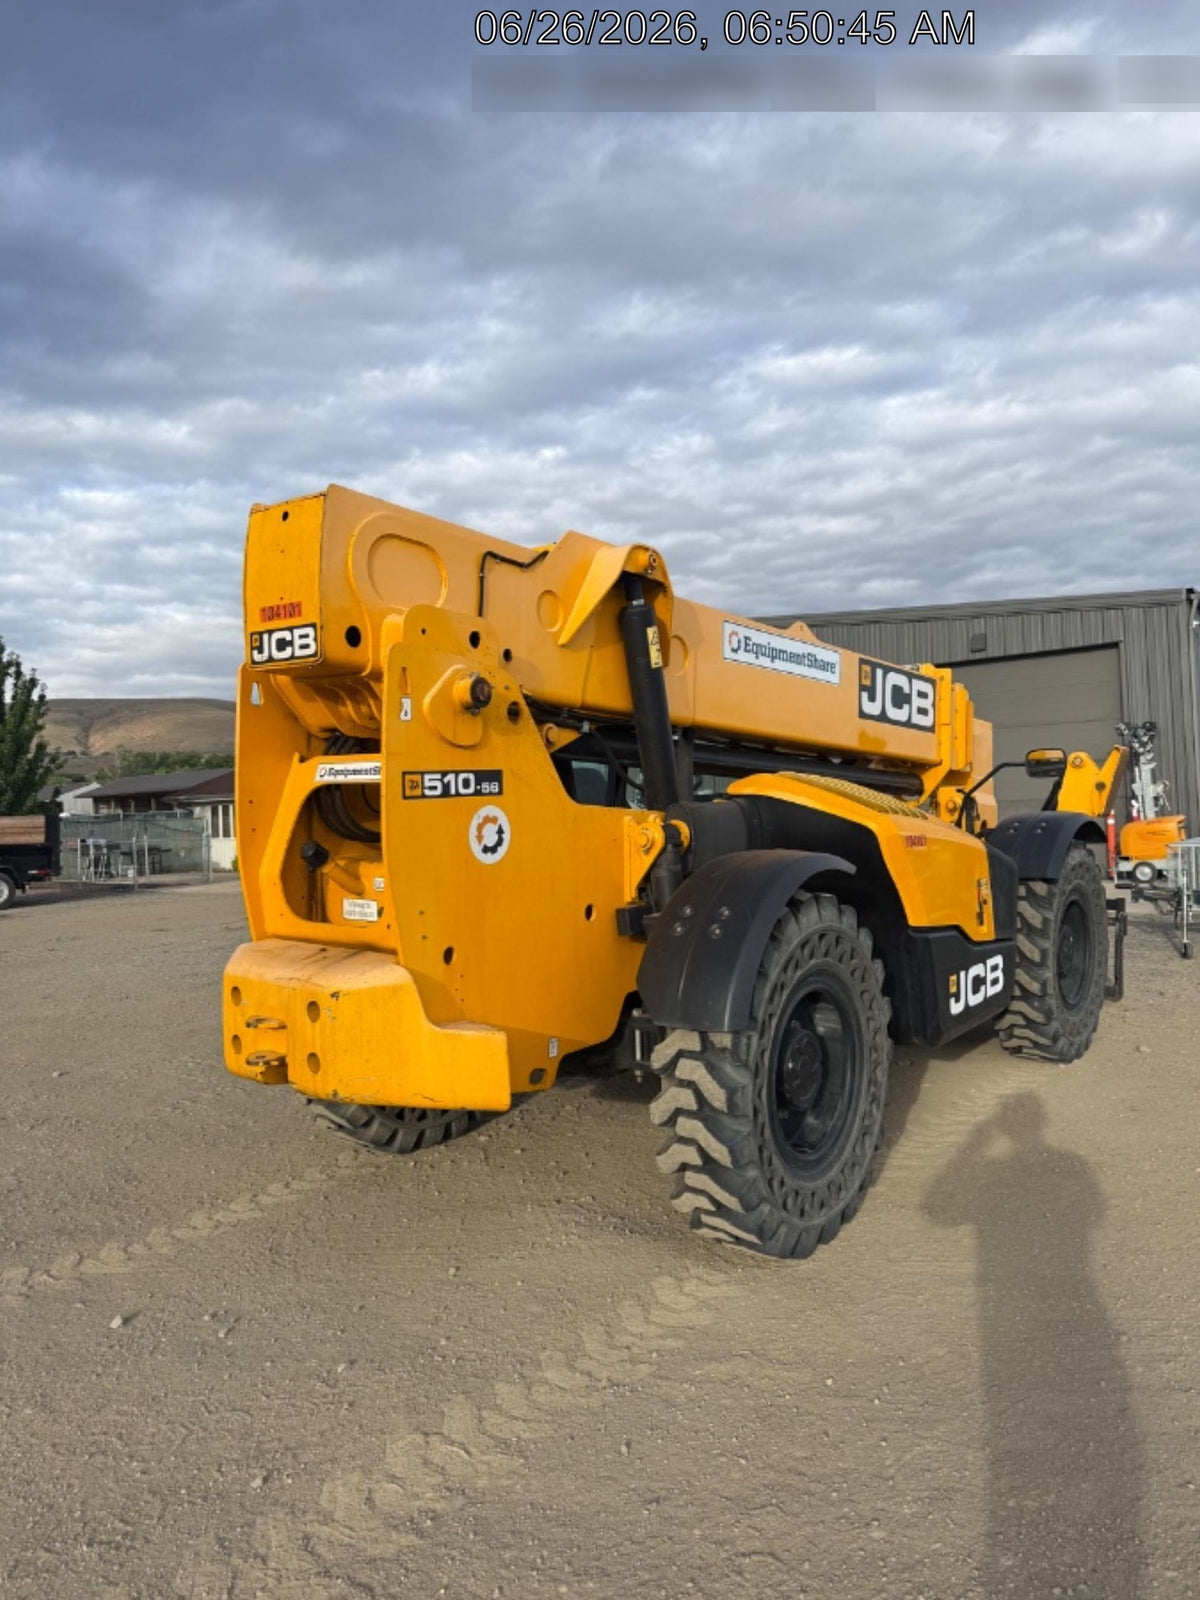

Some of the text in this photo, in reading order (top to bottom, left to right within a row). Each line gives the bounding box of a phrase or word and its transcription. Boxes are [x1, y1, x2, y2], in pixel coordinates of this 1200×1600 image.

[252, 626, 317, 662] JCB
[743, 635, 837, 675] EquipmentShare
[861, 667, 934, 728] JCB
[949, 953, 1004, 1016] JCB
